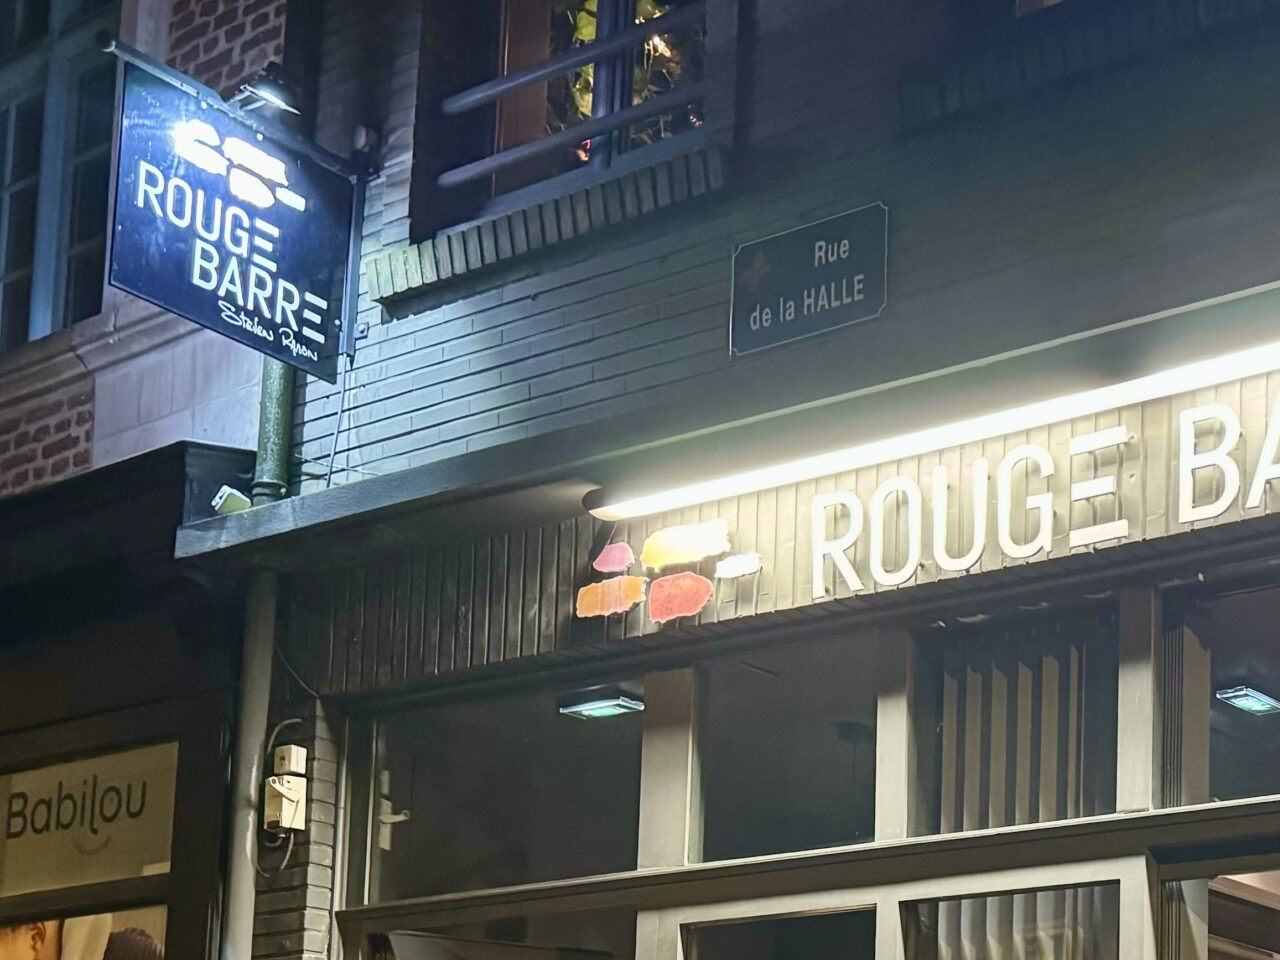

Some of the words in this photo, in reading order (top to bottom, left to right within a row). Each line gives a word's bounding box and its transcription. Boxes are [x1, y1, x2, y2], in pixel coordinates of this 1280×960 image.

[137, 160, 280, 273] ROUGE
[814, 239, 850, 267] Rue
[192, 238, 328, 344] BARRE
[750, 304, 772, 331] de
[779, 297, 795, 323] la
[803, 274, 865, 315] HALLE
[813, 424, 1129, 599] ROUGE
[5, 774, 147, 840] Babilou
